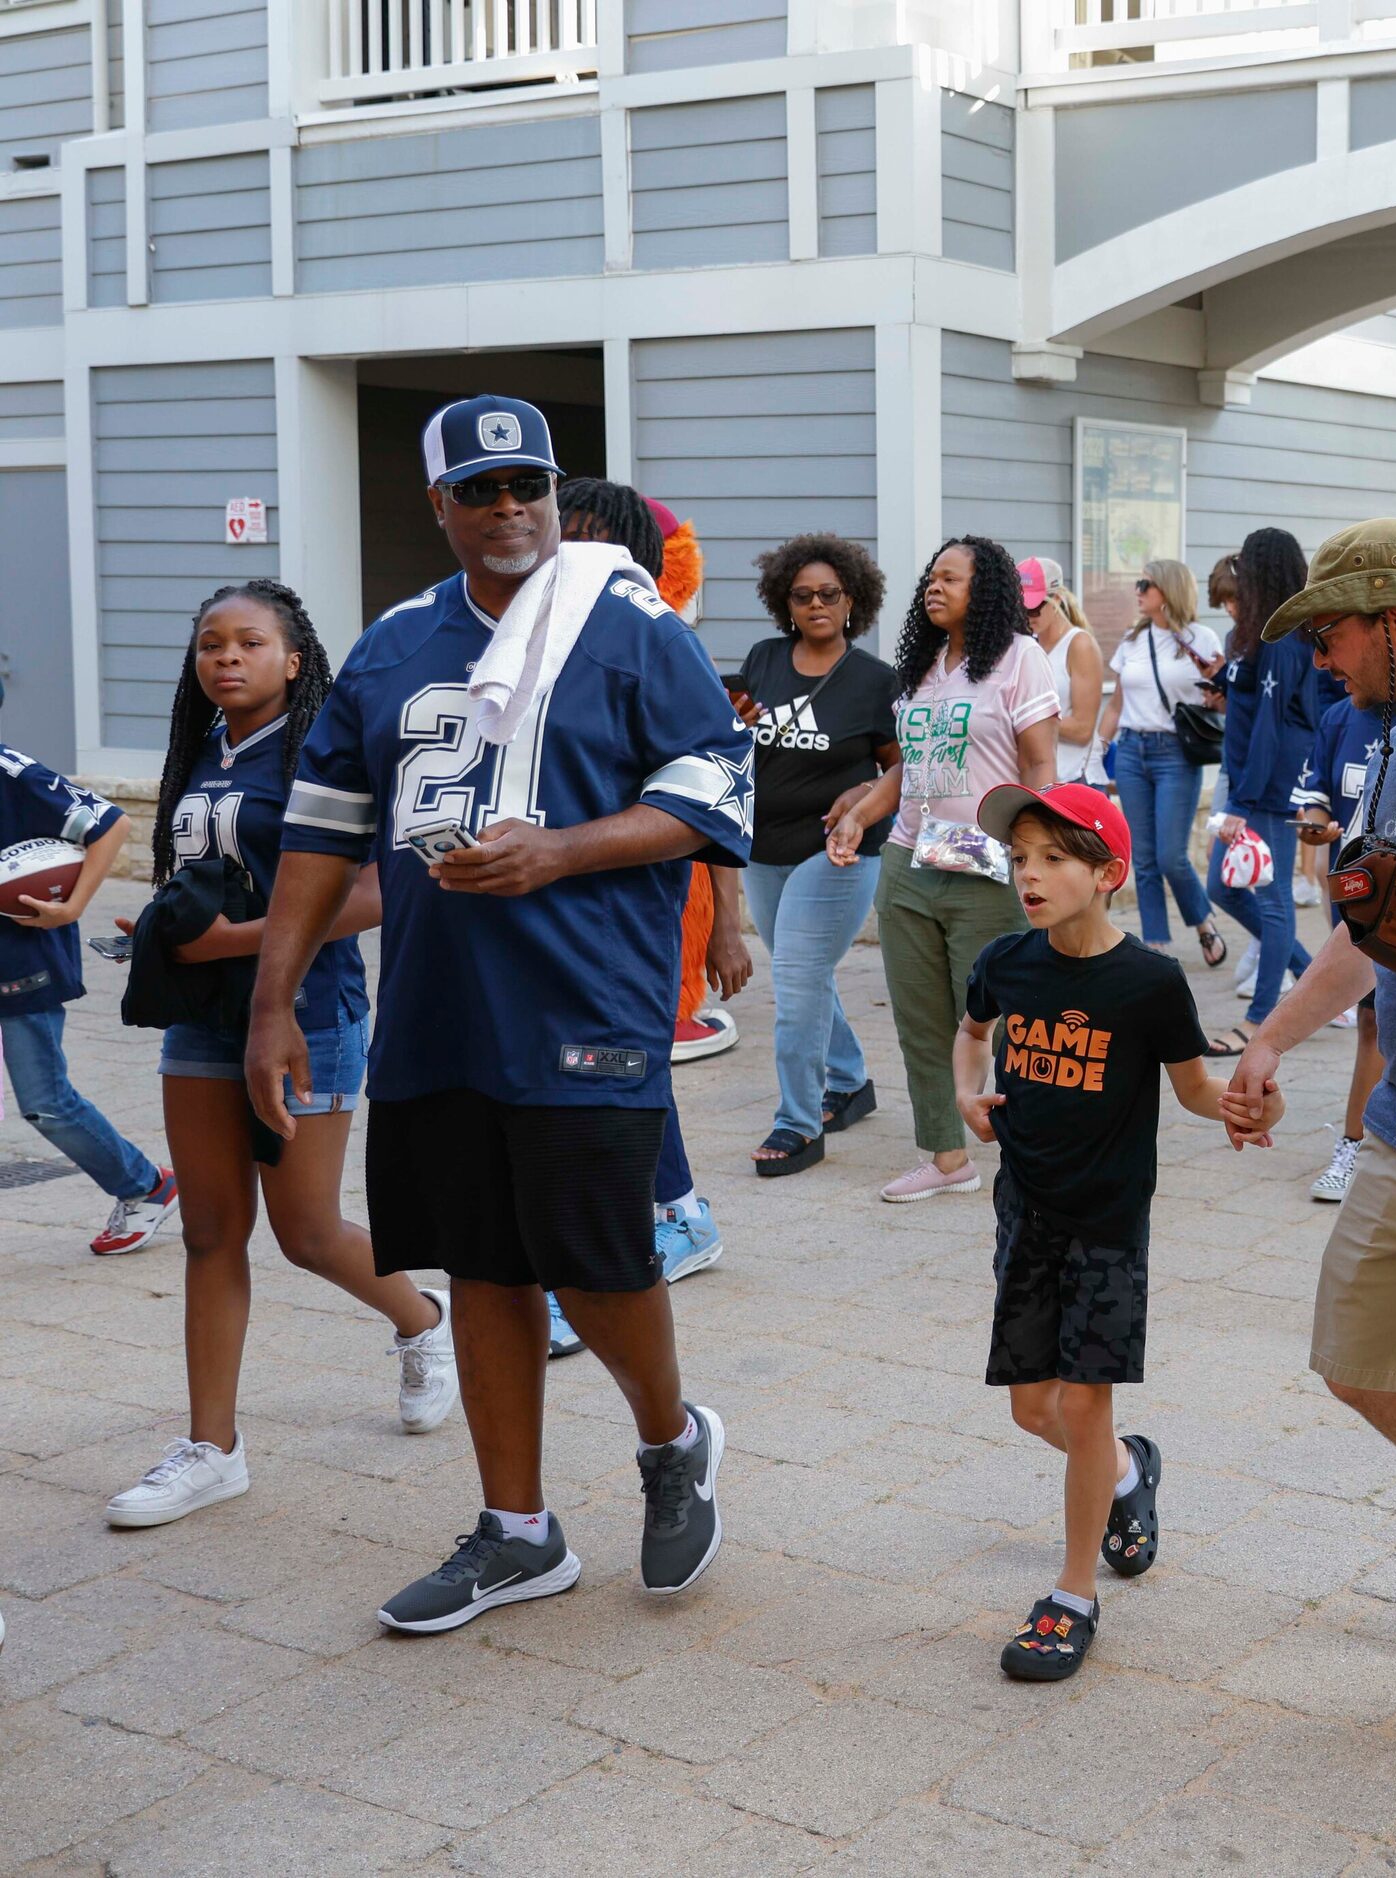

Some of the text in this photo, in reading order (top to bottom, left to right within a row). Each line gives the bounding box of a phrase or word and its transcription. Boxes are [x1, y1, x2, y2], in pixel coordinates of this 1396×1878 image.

[393, 683, 546, 850] 21
[172, 792, 253, 892] 21
[599, 1051, 626, 1064] XXL
[1007, 1014, 1112, 1059] GAME
[1004, 1044, 1105, 1092] MODE
